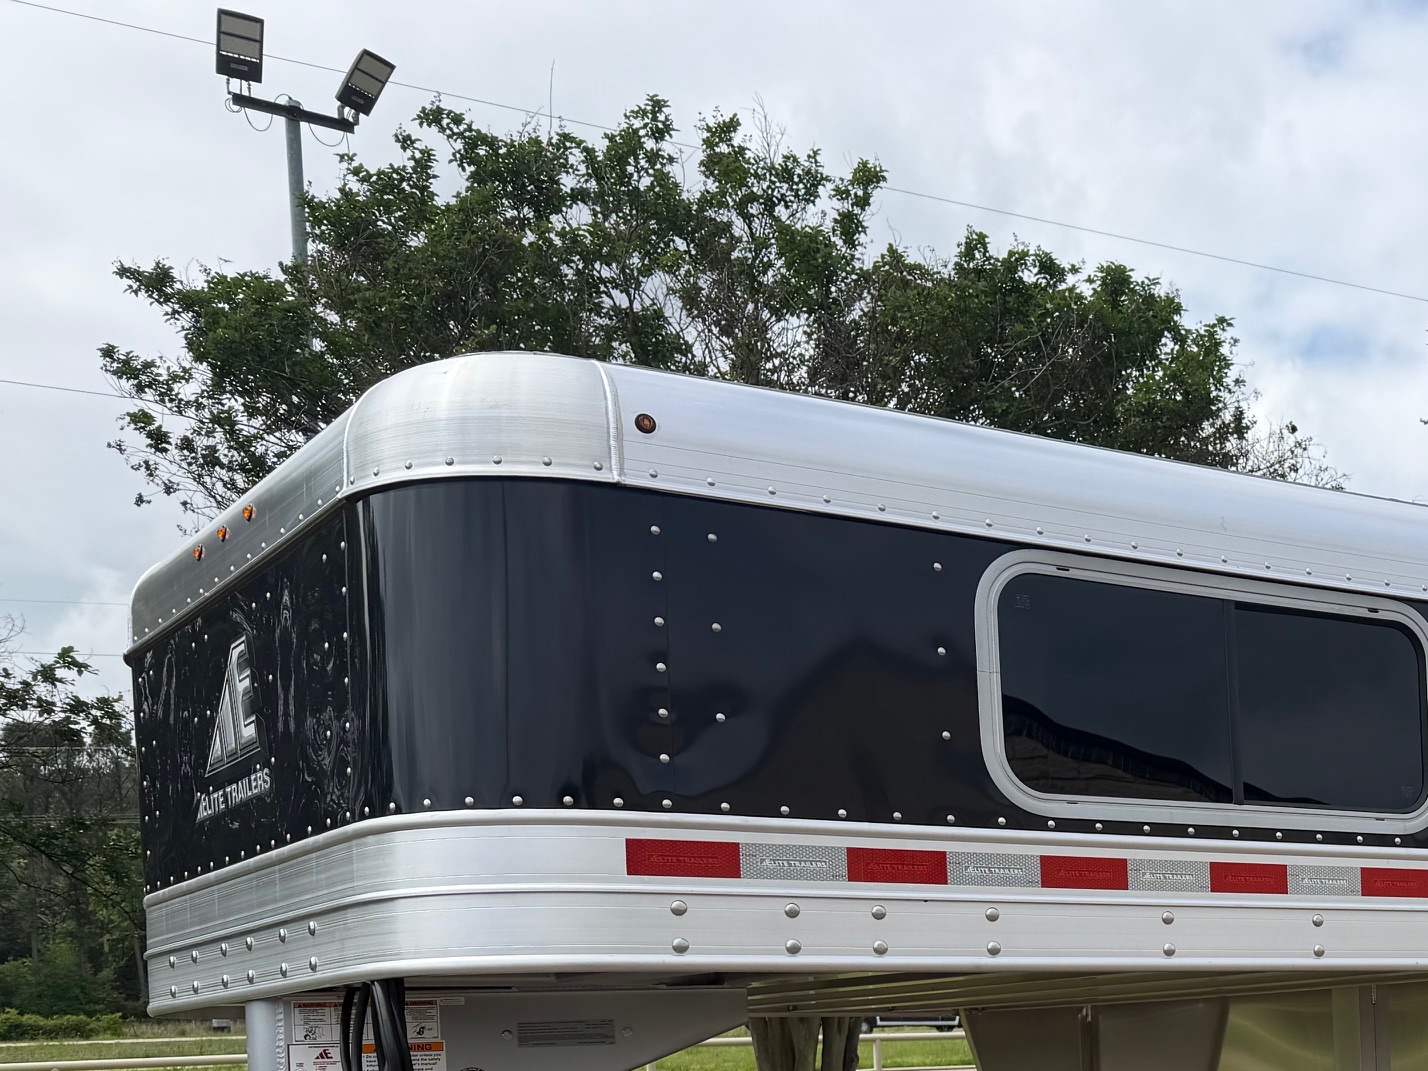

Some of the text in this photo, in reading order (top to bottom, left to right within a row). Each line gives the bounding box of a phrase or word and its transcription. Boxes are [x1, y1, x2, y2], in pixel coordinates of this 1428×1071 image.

[196, 768, 271, 823] ELITE TRAILERS
[760, 859, 828, 869] ELITE TRAILERS
